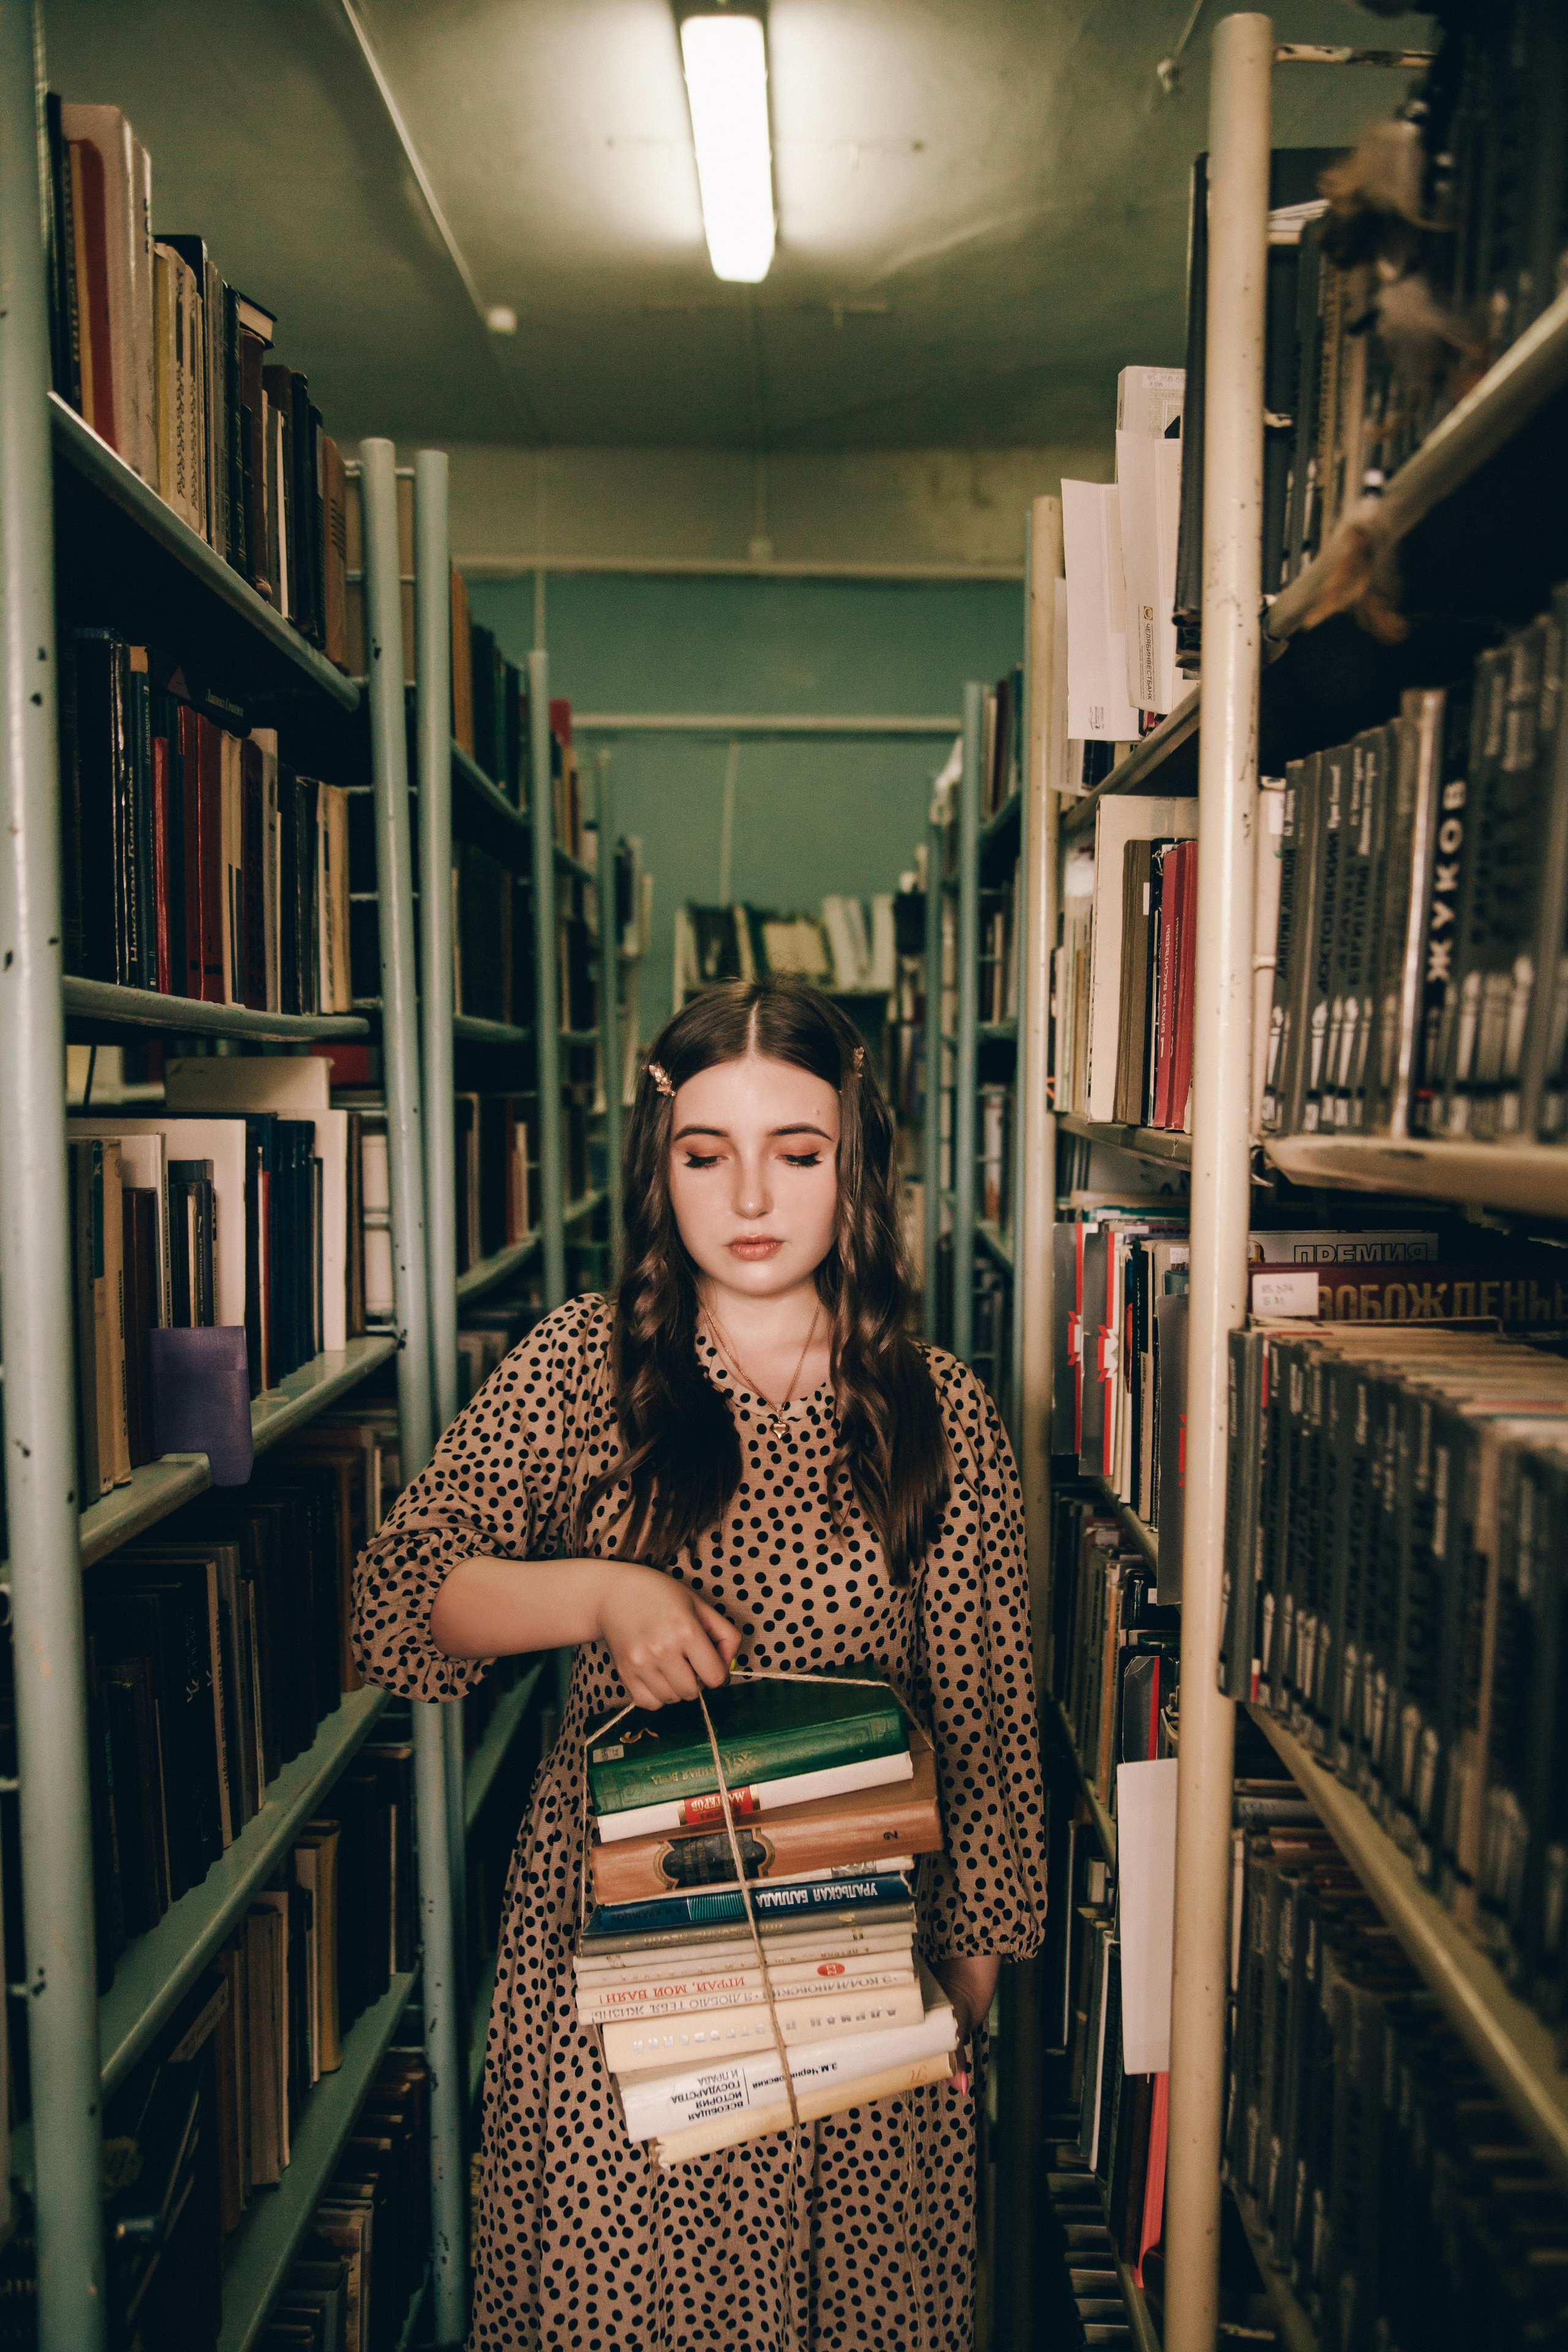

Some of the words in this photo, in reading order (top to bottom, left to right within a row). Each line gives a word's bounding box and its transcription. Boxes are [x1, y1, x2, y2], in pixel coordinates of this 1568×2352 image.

[1427, 778, 1467, 982] ЖУКОВ
[1162, 924, 1171, 991] ВАСИЛЬЕВЫ
[1294, 1243, 1428, 1263] ПРЕМИЯ
[691, 1790, 745, 1812] МАТЕРОВ
[755, 1888, 809, 1908] БАЛЛАДА
[812, 1882, 878, 1902] УРАЛЬСКАЯ
[652, 1984, 687, 2000] МОЙ
[692, 1977, 745, 1994] ИГРАЙ,
[689, 1994, 739, 2010] ЛЮБЛЮ
[590, 2005, 644, 2022] ЖИЗНЬ!
[633, 2020, 797, 2053] ПОТРОВСКИЙ
[697, 2071, 729, 2086] ПРАВА
[731, 2070, 739, 2079] И
[752, 2062, 838, 2090] Э.М.Черниовский
[671, 2080, 741, 2103] ГОСУДАРСТВА
[695, 2090, 742, 2109] ИСТОРИЯ
[688, 2100, 744, 2122] ВСЕОБЩАЯ
